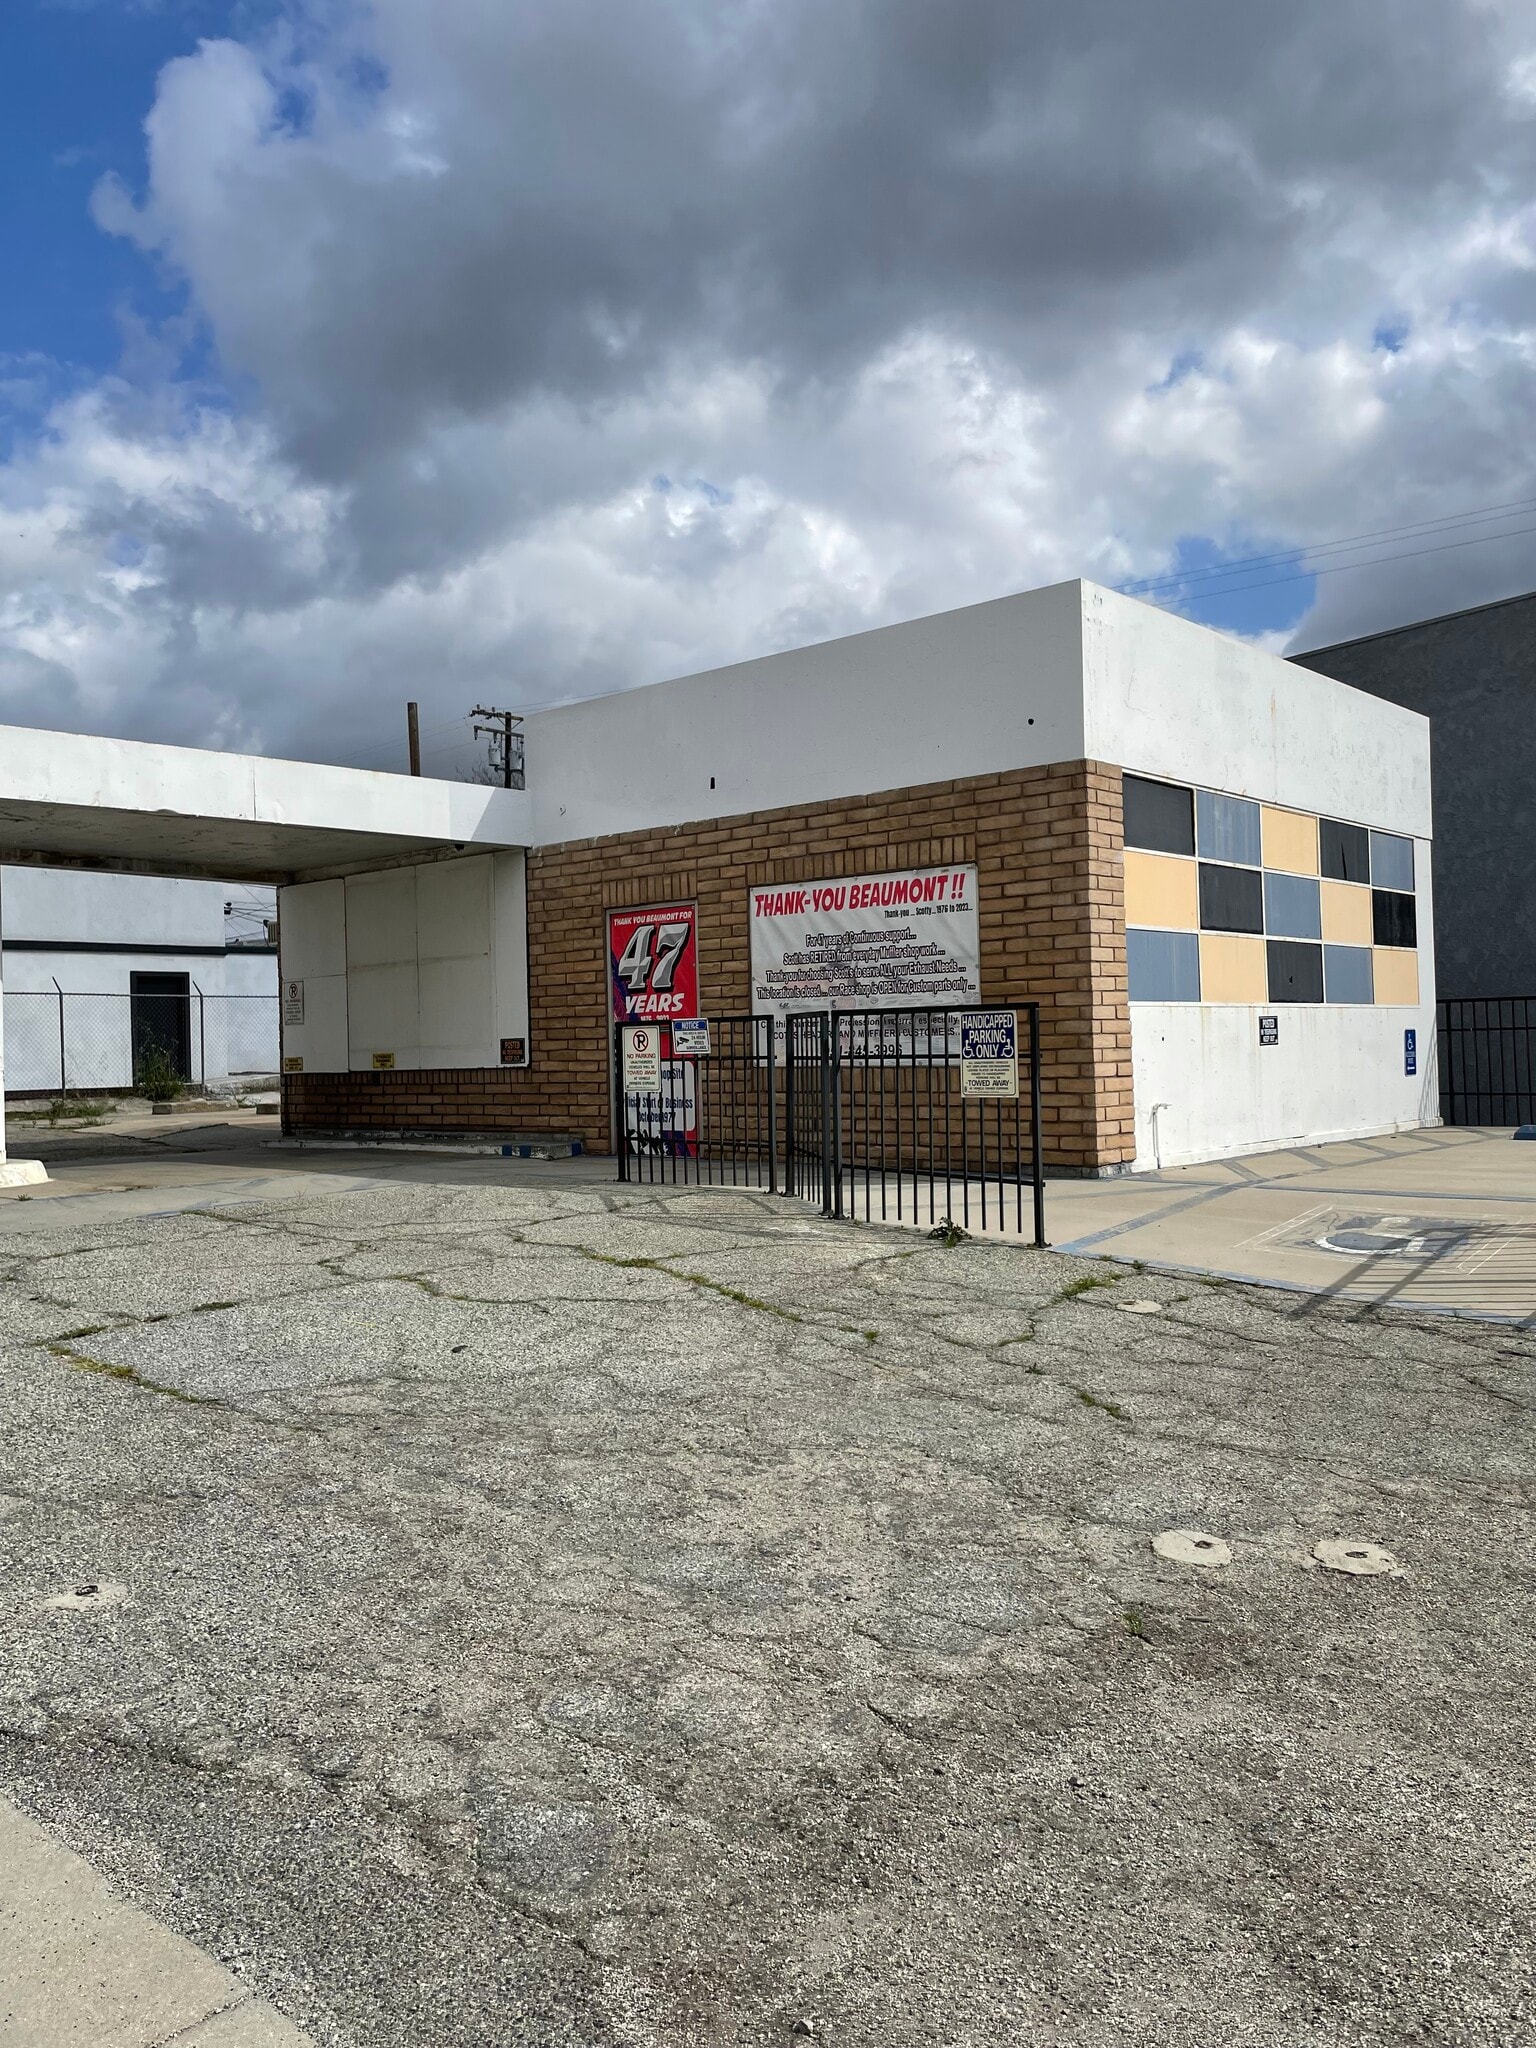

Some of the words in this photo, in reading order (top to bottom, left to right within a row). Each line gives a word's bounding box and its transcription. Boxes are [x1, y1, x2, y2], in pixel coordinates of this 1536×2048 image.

[755, 886, 846, 917] THANK-YOU
[849, 875, 948, 909] BEAUMONT
[936, 904, 949, 914] 1976
[949, 904, 955, 912] to
[614, 917, 632, 926] THANK
[633, 915, 646, 924] YOU
[646, 912, 679, 922] BEAUMONT
[679, 911, 692, 919] FOR
[806, 934, 817, 947] For
[824, 935, 842, 948] years
[842, 931, 849, 944] of
[850, 930, 884, 944] Continuous
[618, 922, 691, 992] 47
[809, 949, 836, 963] RETIRED
[836, 949, 852, 961] from
[852, 947, 879, 963] everyday
[902, 944, 919, 959] shop
[920, 942, 937, 956] work
[798, 969, 807, 981] for
[807, 967, 833, 982] choosing
[854, 965, 862, 978] to
[862, 967, 880, 978] serve
[880, 963, 893, 976] ALL
[893, 965, 909, 978] your
[909, 961, 935, 975] Exhaust
[935, 959, 958, 973] Needs
[756, 986, 770, 999] This
[770, 985, 794, 999] location
[794, 985, 801, 998] is
[801, 984, 821, 997] closed
[828, 986, 839, 997] our
[839, 983, 855, 996] Race
[855, 982, 871, 998] shop
[871, 981, 879, 995] is
[879, 980, 898, 994] OPEN
[898, 980, 908, 993] for
[908, 979, 933, 993] Custom
[933, 977, 952, 994] parts
[952, 976, 968, 993] only
[626, 993, 685, 1013] YEARS
[681, 1021, 699, 1029] NOTICE
[962, 1014, 1013, 1030] HANDICAPPED
[969, 1029, 1006, 1044] PARKING
[976, 1044, 999, 1058] ONLY
